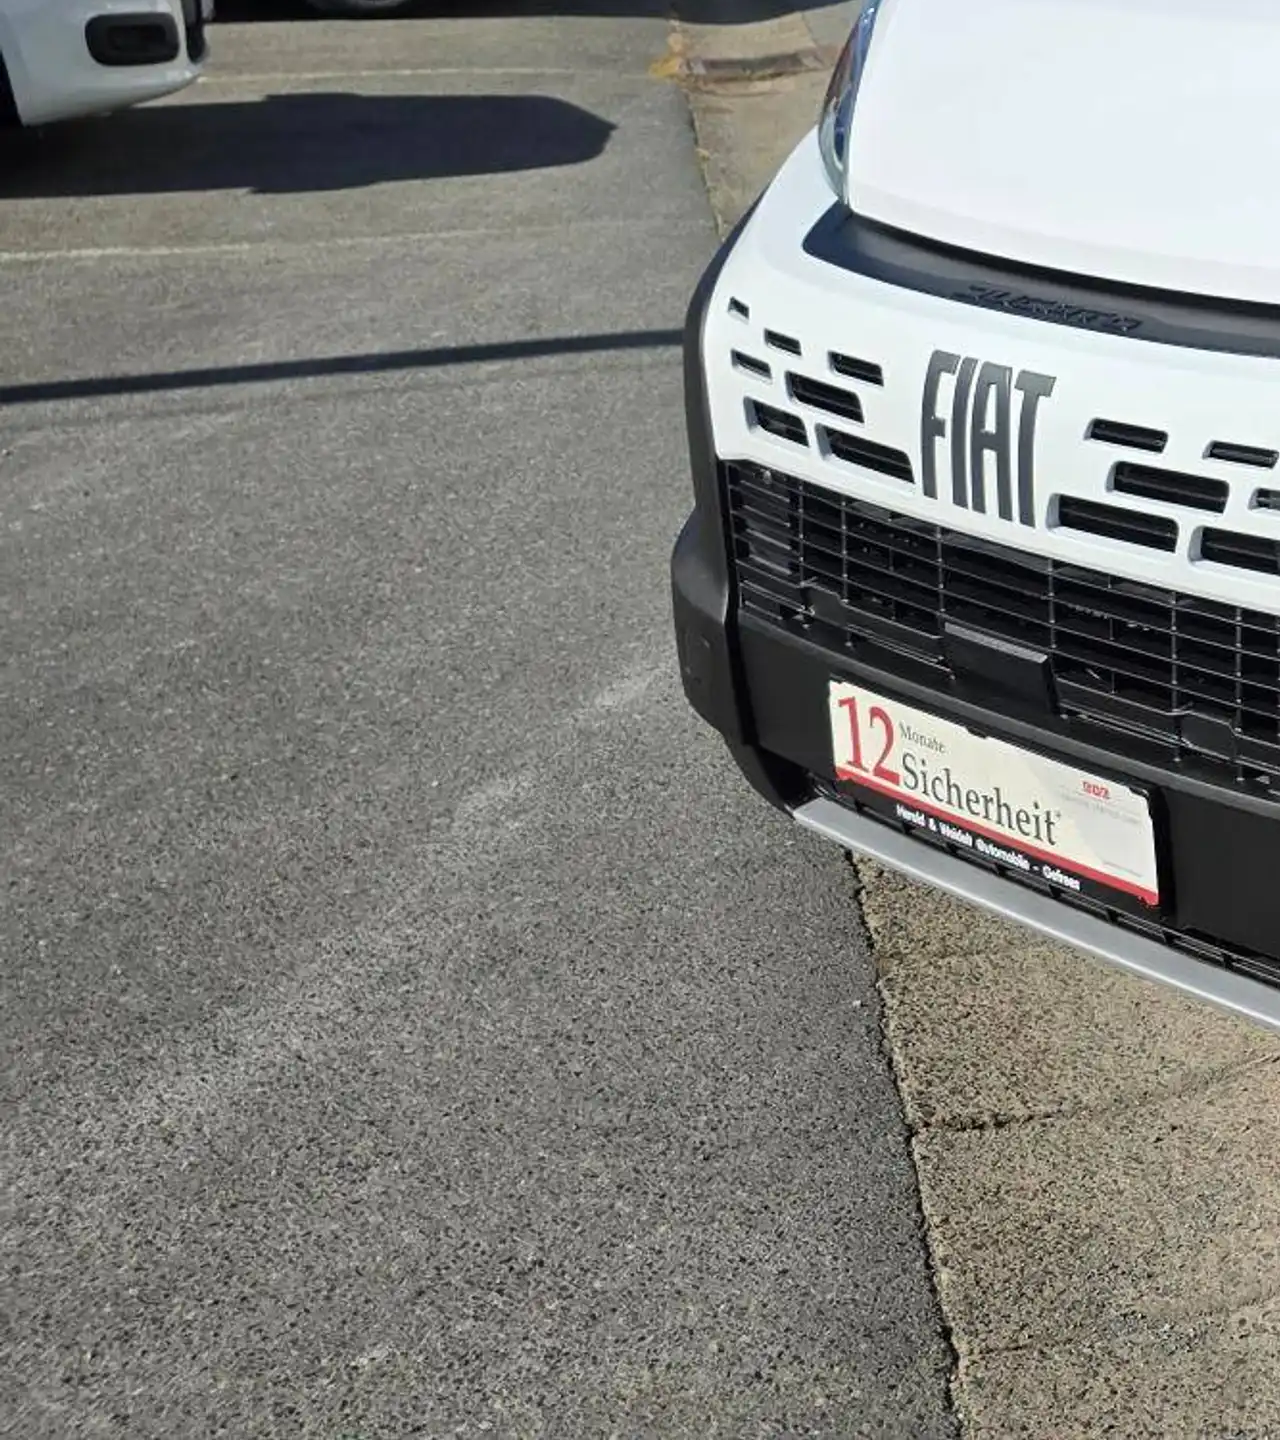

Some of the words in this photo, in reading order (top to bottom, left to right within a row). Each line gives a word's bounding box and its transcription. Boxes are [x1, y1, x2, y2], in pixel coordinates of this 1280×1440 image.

[921, 349, 1057, 529] FIAT
[838, 696, 899, 786] 12
[899, 720, 947, 754] Monate
